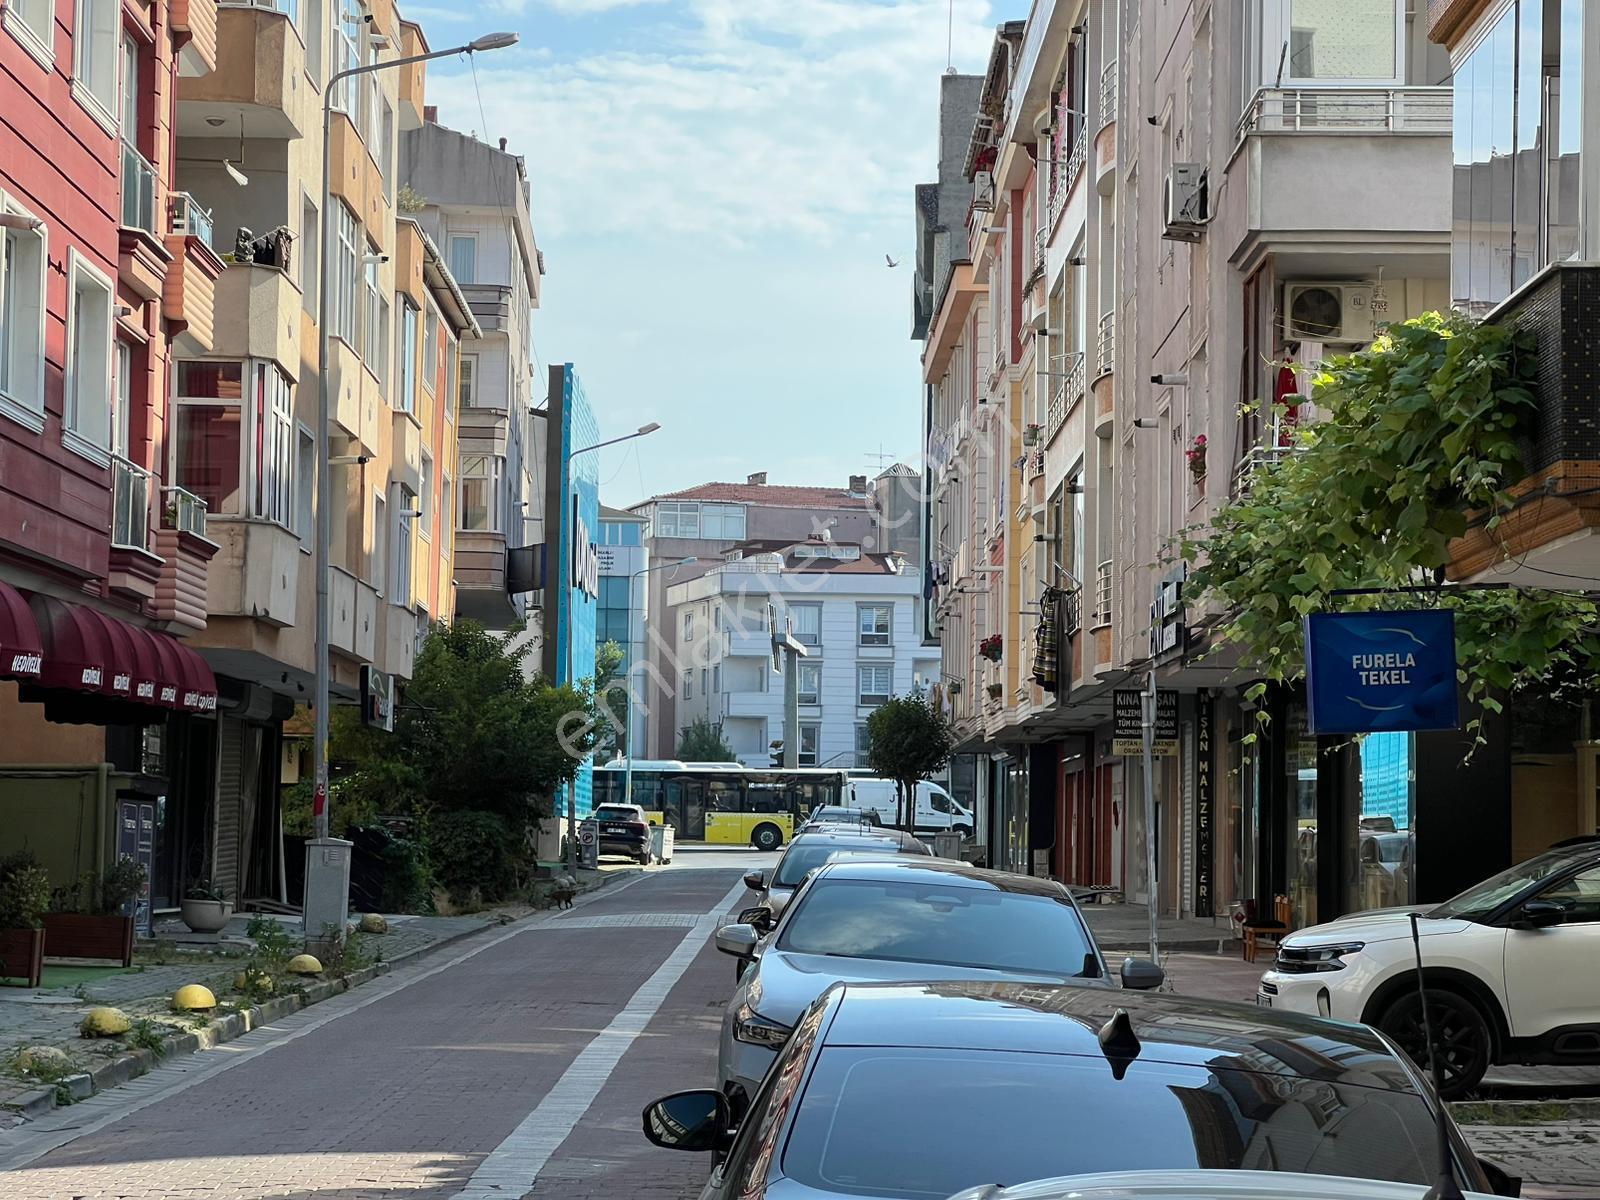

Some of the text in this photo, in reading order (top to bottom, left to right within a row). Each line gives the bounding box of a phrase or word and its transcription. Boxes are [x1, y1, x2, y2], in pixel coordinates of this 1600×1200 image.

[1352, 653, 1416, 669] FURELA
[1359, 670, 1410, 685] TEKEL
[1116, 693, 1176, 707] KINA ŞAN
[1118, 719, 1131, 727] TÜM
[1131, 719, 1143, 727] KIN
